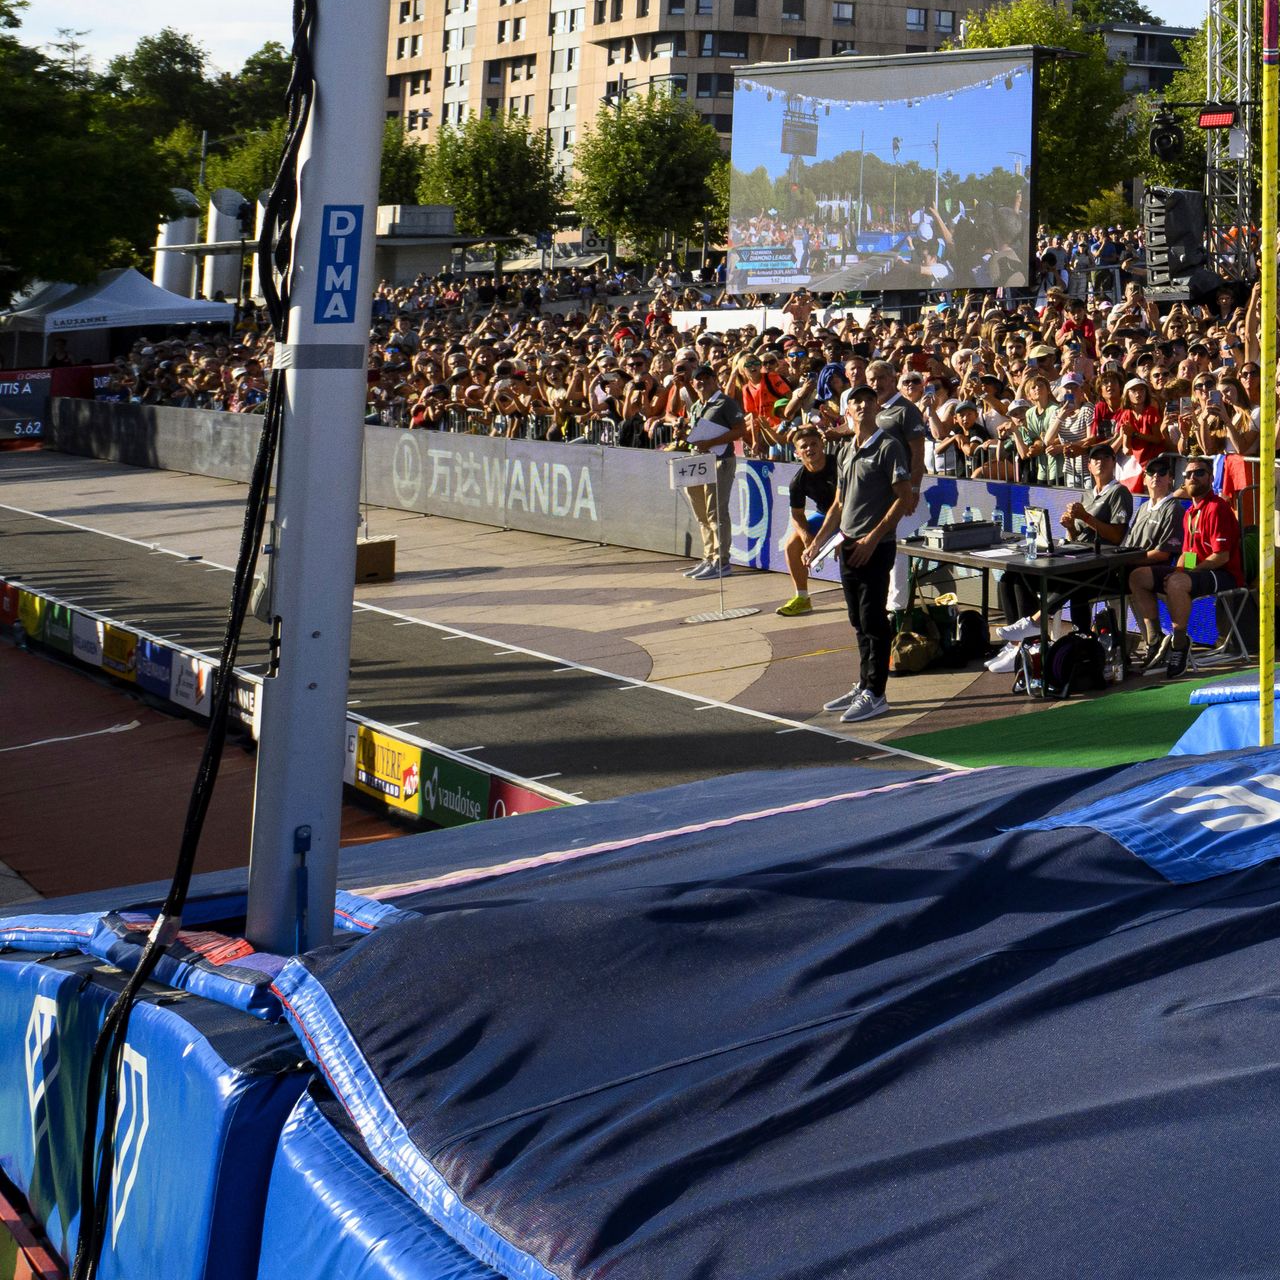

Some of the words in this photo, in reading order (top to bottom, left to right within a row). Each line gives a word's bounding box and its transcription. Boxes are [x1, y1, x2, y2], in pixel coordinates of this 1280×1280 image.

[323, 210, 357, 319] DIMA
[14, 421, 41, 435] 5.62
[679, 462, 708, 477] +75
[438, 786, 481, 821] vaudoise
